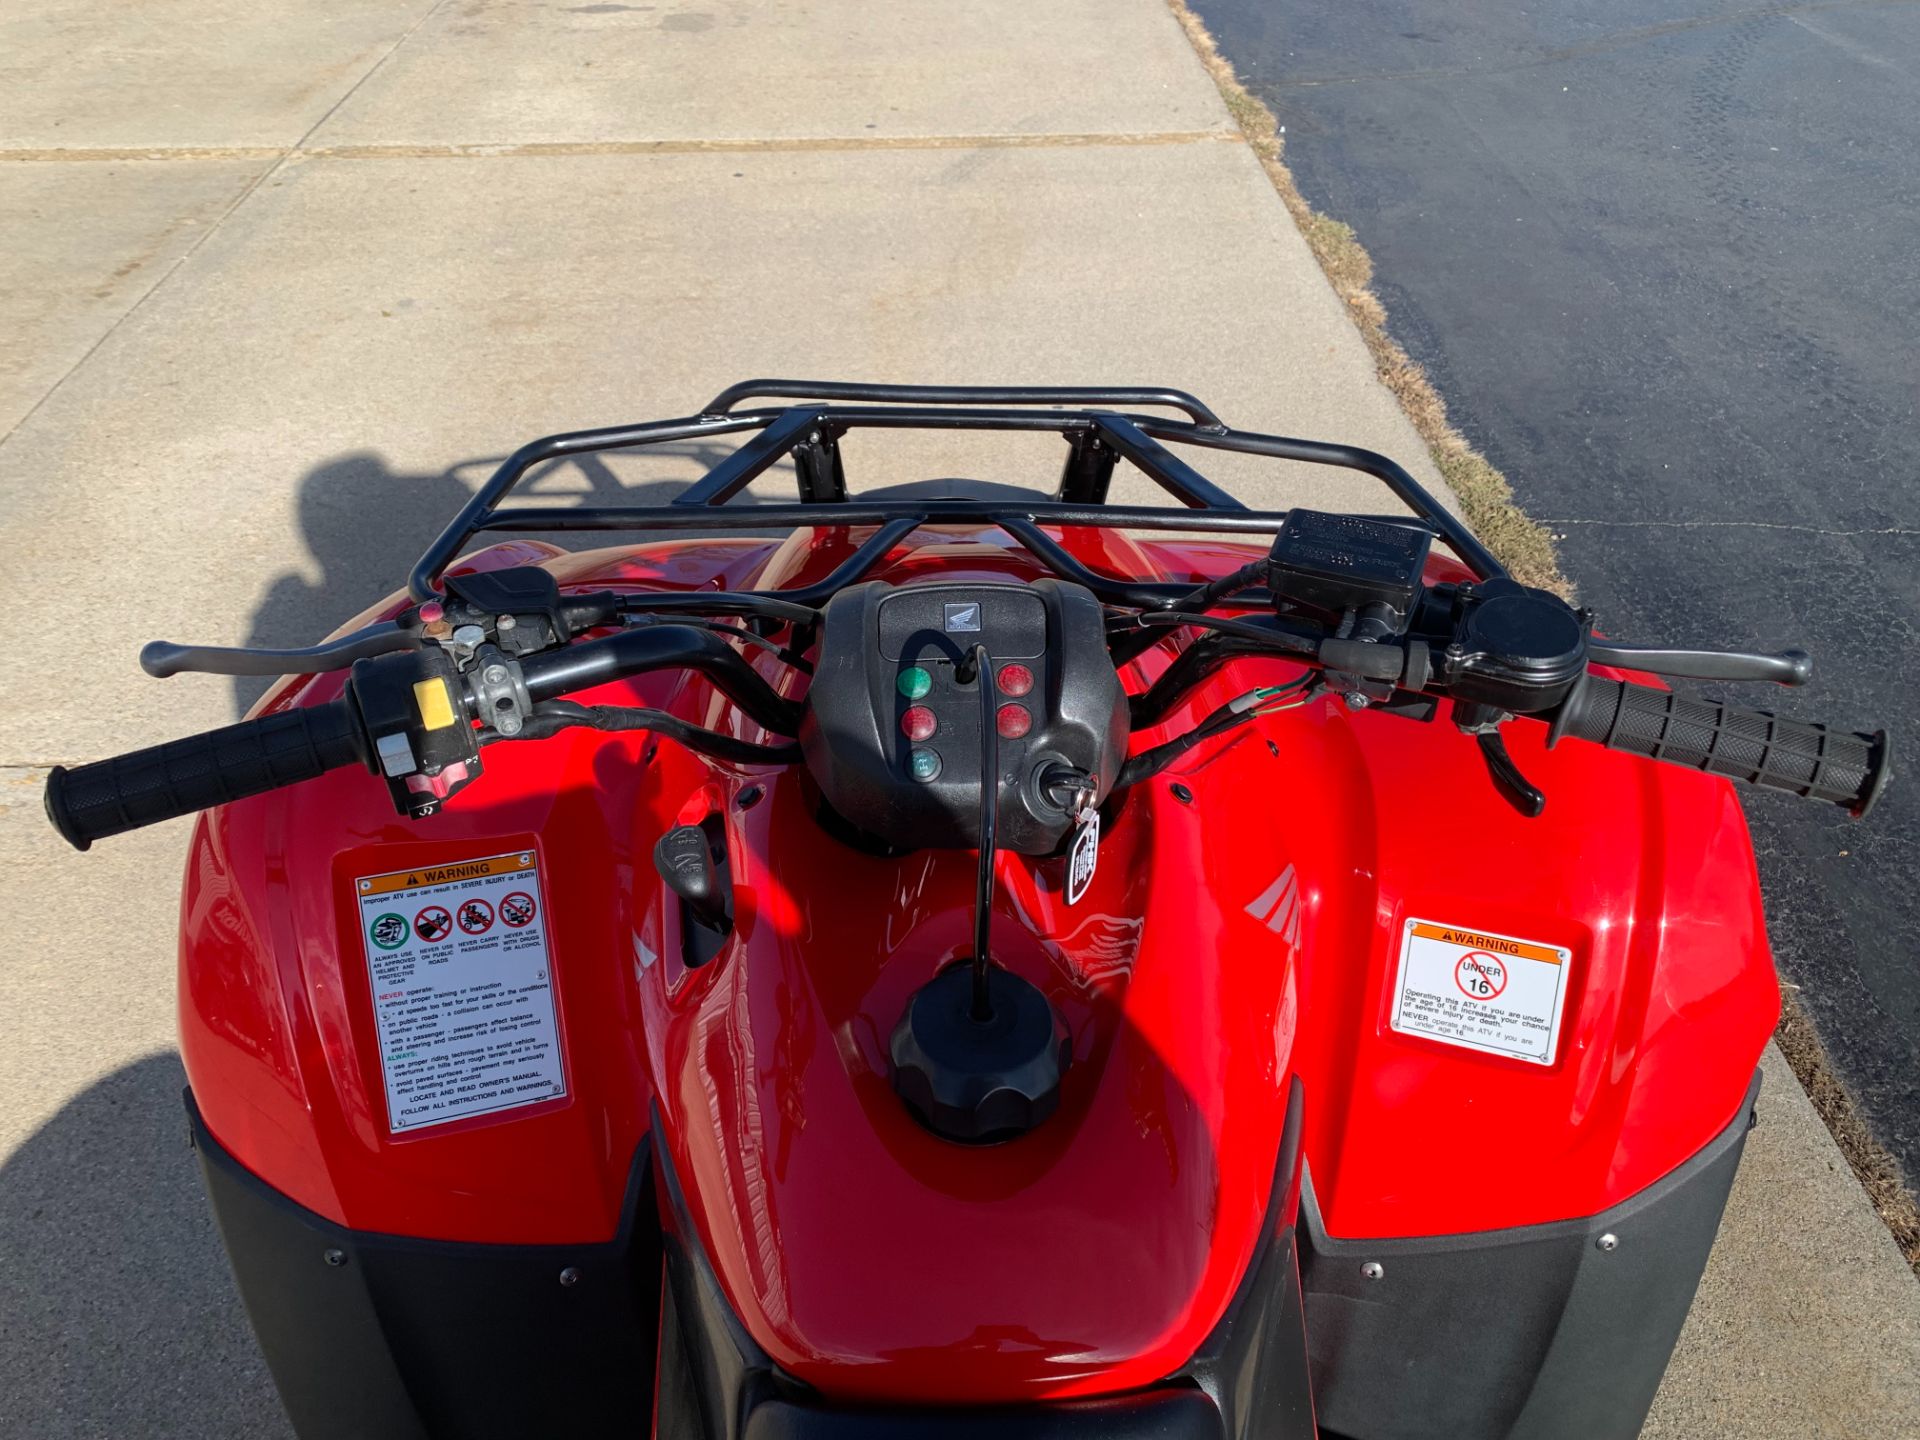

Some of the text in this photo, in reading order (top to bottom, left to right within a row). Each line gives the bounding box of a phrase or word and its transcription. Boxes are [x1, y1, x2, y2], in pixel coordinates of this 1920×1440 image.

[425, 863, 490, 882] WARNING
[363, 895, 390, 905] Improper
[461, 881, 482, 889] SEVERE
[485, 877, 506, 885] INJURY
[517, 872, 535, 880] DEATH
[433, 950, 454, 958] PUBLIC
[461, 942, 499, 953] PASSENGERS
[514, 941, 541, 949] ALCOHOL
[1454, 933, 1519, 954] WARNING
[374, 954, 398, 962] ALWAYS
[384, 957, 416, 966] APPROVED
[1462, 962, 1501, 977] UNDER
[375, 966, 399, 974] HELMET
[378, 970, 414, 980] PROTECTIVE
[379, 991, 403, 1001] NEVER
[385, 999, 408, 1009] without
[411, 995, 430, 1004] proper
[434, 990, 458, 1000] training
[470, 982, 502, 993] instruction
[1469, 978, 1490, 995] 16
[406, 1006, 427, 1015] speeds
[466, 996, 479, 1004] your
[482, 993, 497, 1001] skills
[519, 983, 548, 994] conditions
[1405, 989, 1441, 1002] Operating
[1445, 997, 1459, 1006] this
[1463, 1001, 1478, 1010] ATV
[1490, 1007, 1505, 1015] you
[1508, 1011, 1521, 1019] are
[1522, 1014, 1545, 1024] under
[399, 1017, 418, 1026] public
[421, 1013, 439, 1022] roads
[454, 1006, 479, 1015] collision
[496, 999, 513, 1007] occur
[1415, 1004, 1439, 1014] severe
[1443, 1010, 1464, 1020] injury
[1479, 1018, 1503, 1028] death.
[1420, 998, 1434, 1006] age
[1461, 1007, 1497, 1020] increases
[1500, 1016, 1519, 1025] your
[1522, 1020, 1550, 1032] chance
[389, 1022, 437, 1035] another vehicle
[390, 1038, 403, 1046] with
[413, 1030, 445, 1041] passenger
[453, 1022, 488, 1033] passengers
[510, 1013, 533, 1022] balance
[406, 1040, 431, 1050] steering
[434, 1037, 446, 1045] and
[448, 1032, 474, 1042] increase
[499, 1024, 518, 1032] losing
[520, 1019, 541, 1028] control
[1402, 1011, 1429, 1022] NEVER
[1432, 1018, 1458, 1029] operate
[1462, 1024, 1474, 1032] this
[1478, 1028, 1493, 1037] ATV
[1504, 1034, 1518, 1042] you
[1521, 1037, 1534, 1046] are
[1414, 1021, 1434, 1030] under
[395, 1067, 424, 1078] overturns
[468, 1055, 486, 1063] rough
[488, 1050, 508, 1059] terrain
[533, 1042, 549, 1050] turns
[408, 1059, 428, 1068] proper
[431, 1055, 449, 1063] riding
[451, 1048, 484, 1059] techniques
[496, 1042, 512, 1050] avoid
[514, 1037, 536, 1046] vehicle
[396, 1080, 413, 1088] avoid
[416, 1075, 434, 1084] paved
[437, 1069, 463, 1079] surfaces
[471, 1062, 500, 1073] pavement
[518, 1053, 545, 1063] seriously
[397, 1087, 414, 1095] affect
[417, 1081, 443, 1091] handling
[460, 1073, 481, 1082] control
[409, 1092, 437, 1103] LOCATE
[457, 1084, 476, 1093] READ
[479, 1077, 510, 1088] OWNER'S
[513, 1071, 542, 1082] MANUAL.
[401, 1105, 430, 1116] FOLLOW
[449, 1091, 497, 1106] INSTRUCTIONS
[517, 1079, 553, 1092] WARNINGS.
